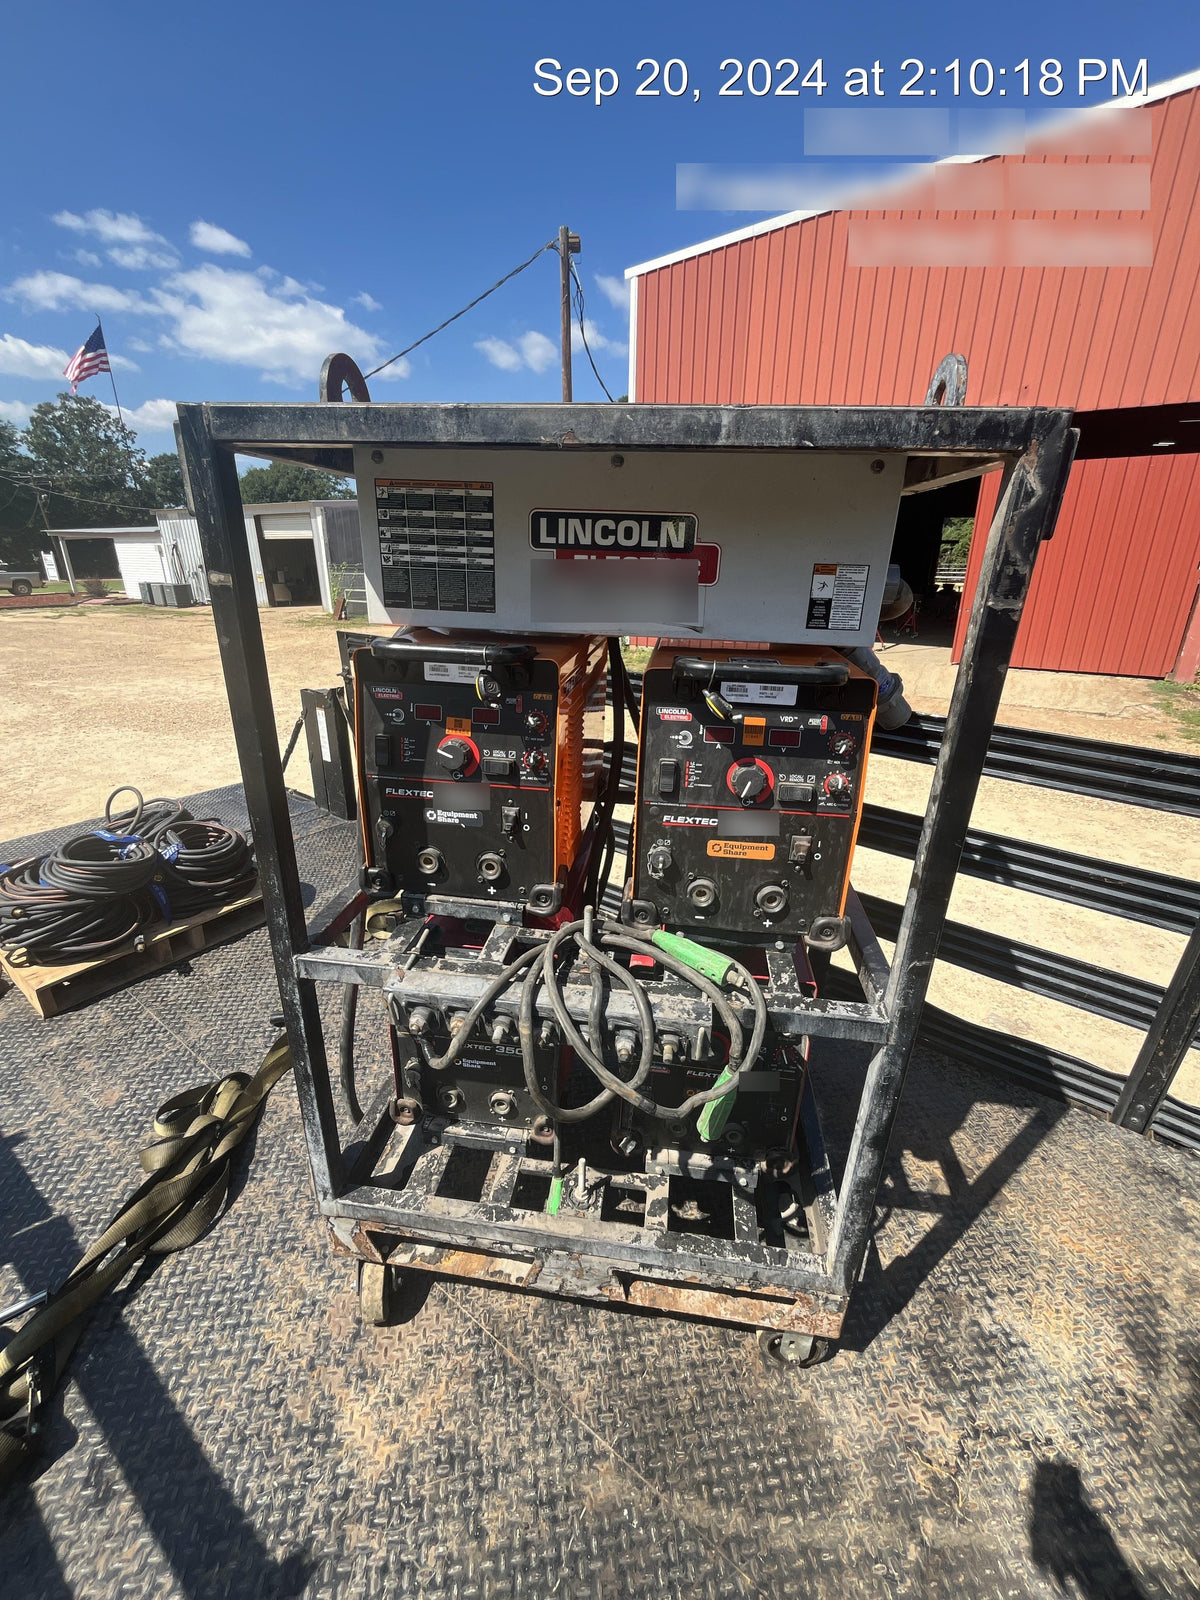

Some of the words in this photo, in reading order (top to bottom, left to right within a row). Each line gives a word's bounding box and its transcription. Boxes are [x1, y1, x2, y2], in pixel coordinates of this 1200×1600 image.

[539, 517, 686, 549] LINCOLN
[385, 787, 434, 798] FLEXTEC
[436, 809, 478, 819] Equipment
[436, 816, 460, 824] Share
[662, 815, 719, 826] FLEXTEC
[723, 842, 769, 852] Equipment
[722, 848, 747, 857] Share
[462, 1058, 497, 1066] Equipment
